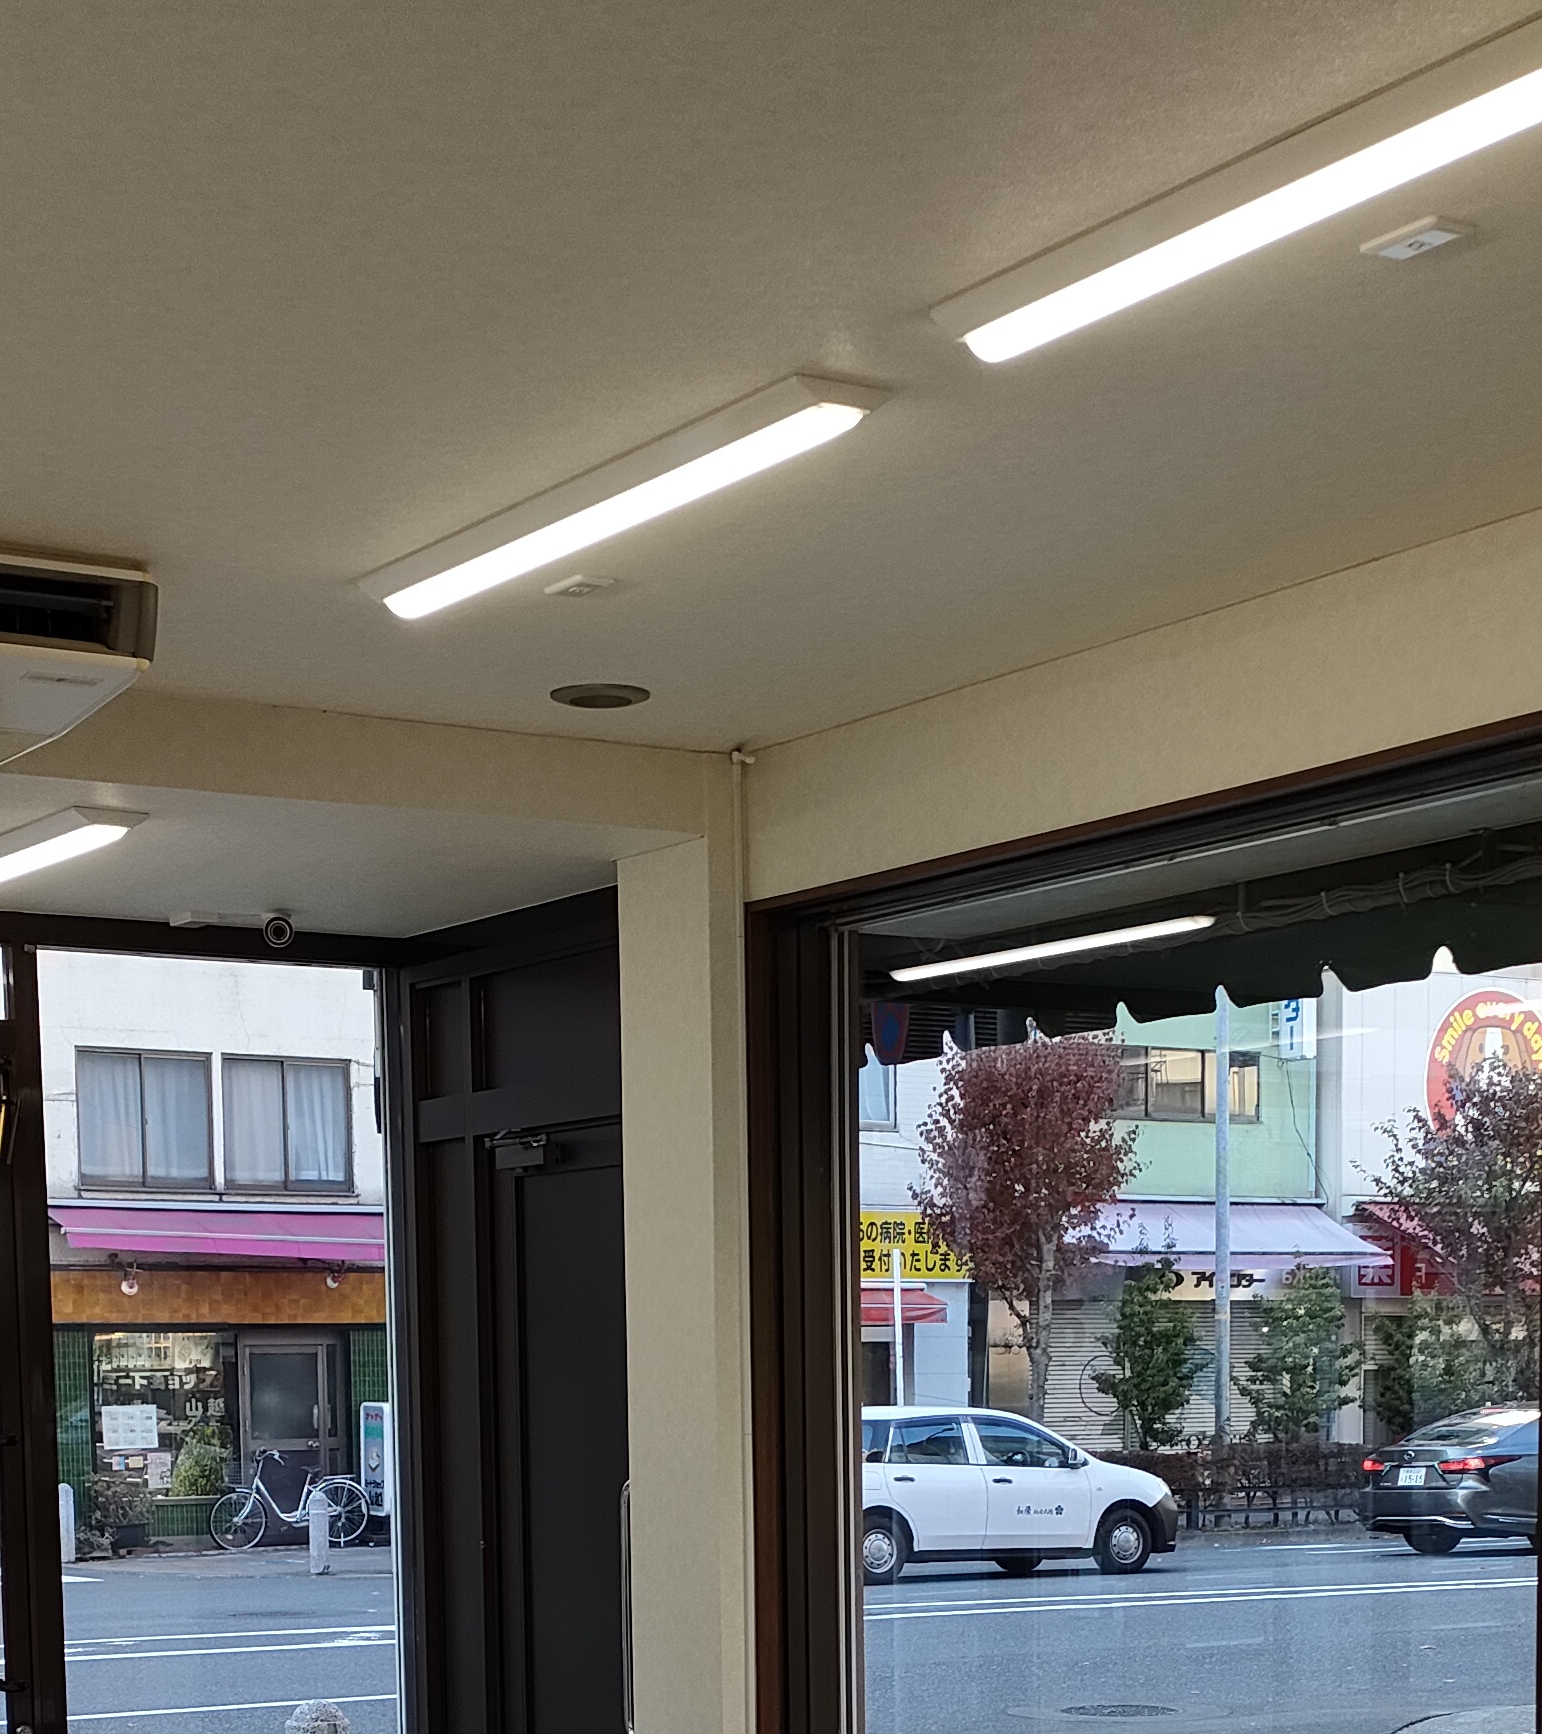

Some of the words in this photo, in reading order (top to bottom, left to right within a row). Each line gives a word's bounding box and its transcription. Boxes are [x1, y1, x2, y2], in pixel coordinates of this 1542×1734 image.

[1434, 1009, 1475, 1064] Smile
[1191, 1271, 1266, 1289] アインター
